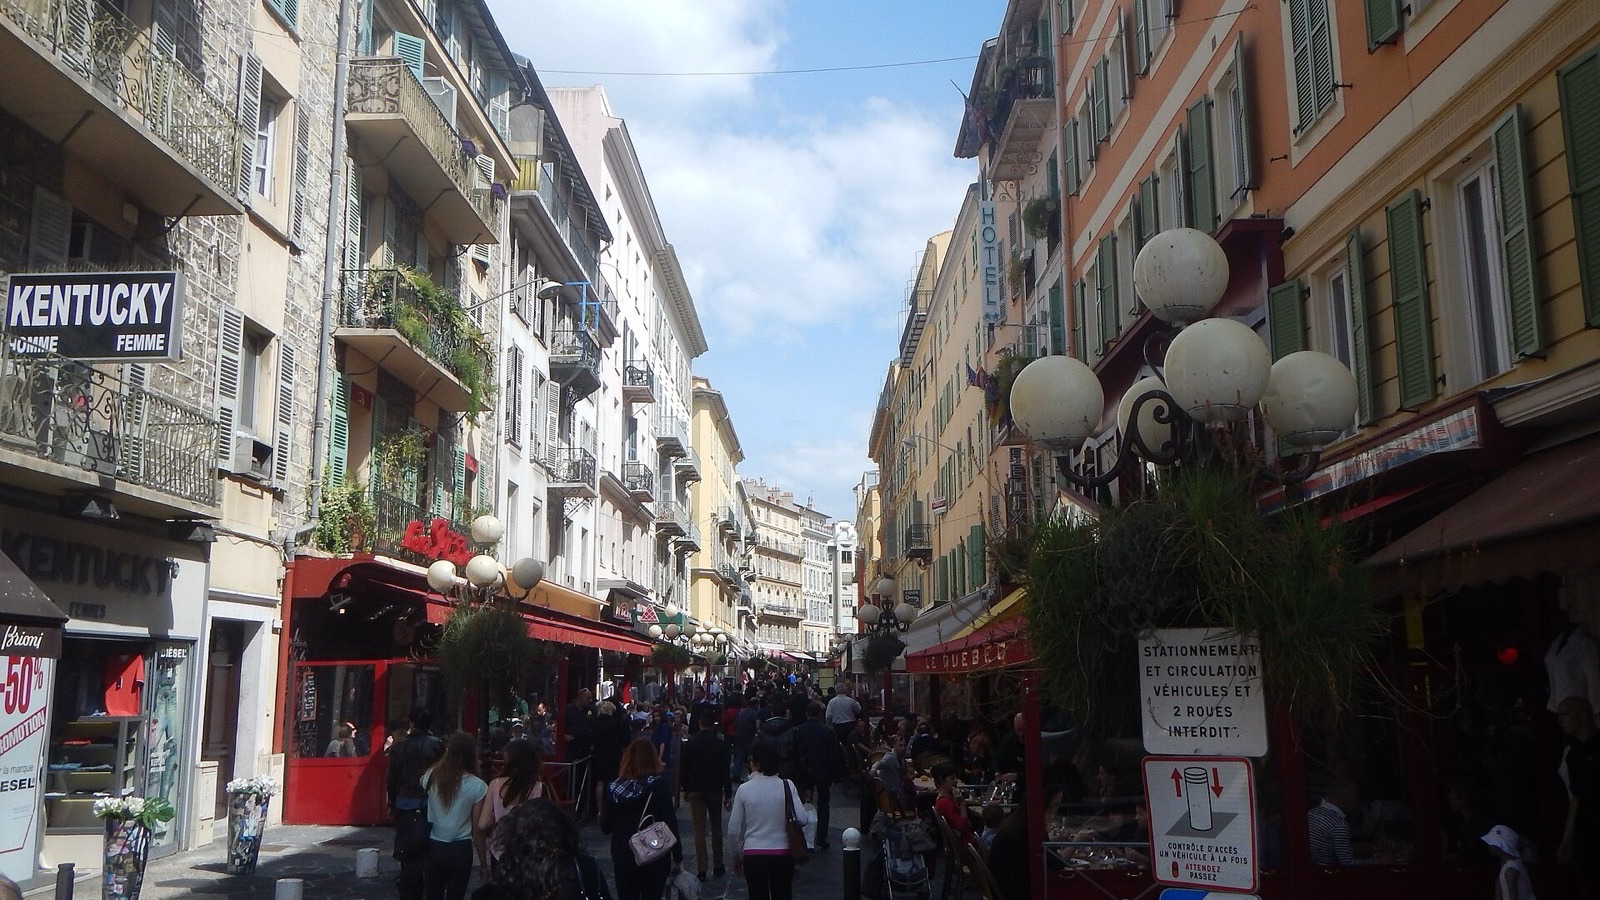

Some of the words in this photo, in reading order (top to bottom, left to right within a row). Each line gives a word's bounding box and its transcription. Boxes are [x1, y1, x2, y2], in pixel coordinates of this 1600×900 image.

[982, 206, 997, 306] HOTEL
[10, 283, 171, 327] KENTUCKY
[116, 334, 165, 352] FEMME
[1, 625, 45, 649] Brioni
[1144, 645, 1256, 657] STATIONNEMENT
[925, 656, 937, 669] LE
[1146, 666, 1161, 677] ET
[1167, 665, 1257, 677] CIRCULATION
[1153, 683, 1228, 697] VÉHICULES
[1235, 685, 1251, 697] ET
[1173, 706, 1181, 717] 2
[1187, 706, 1233, 717] ROUES
[10, 764, 34, 775] marque
[1168, 842, 1204, 852] CONTRÔLE
[1172, 851, 1207, 861] VÉHICULE
[1230, 857, 1248, 865] FOIS
[1185, 863, 1221, 873] ATTENDEZ
[1190, 872, 1217, 882] PASSEZ
